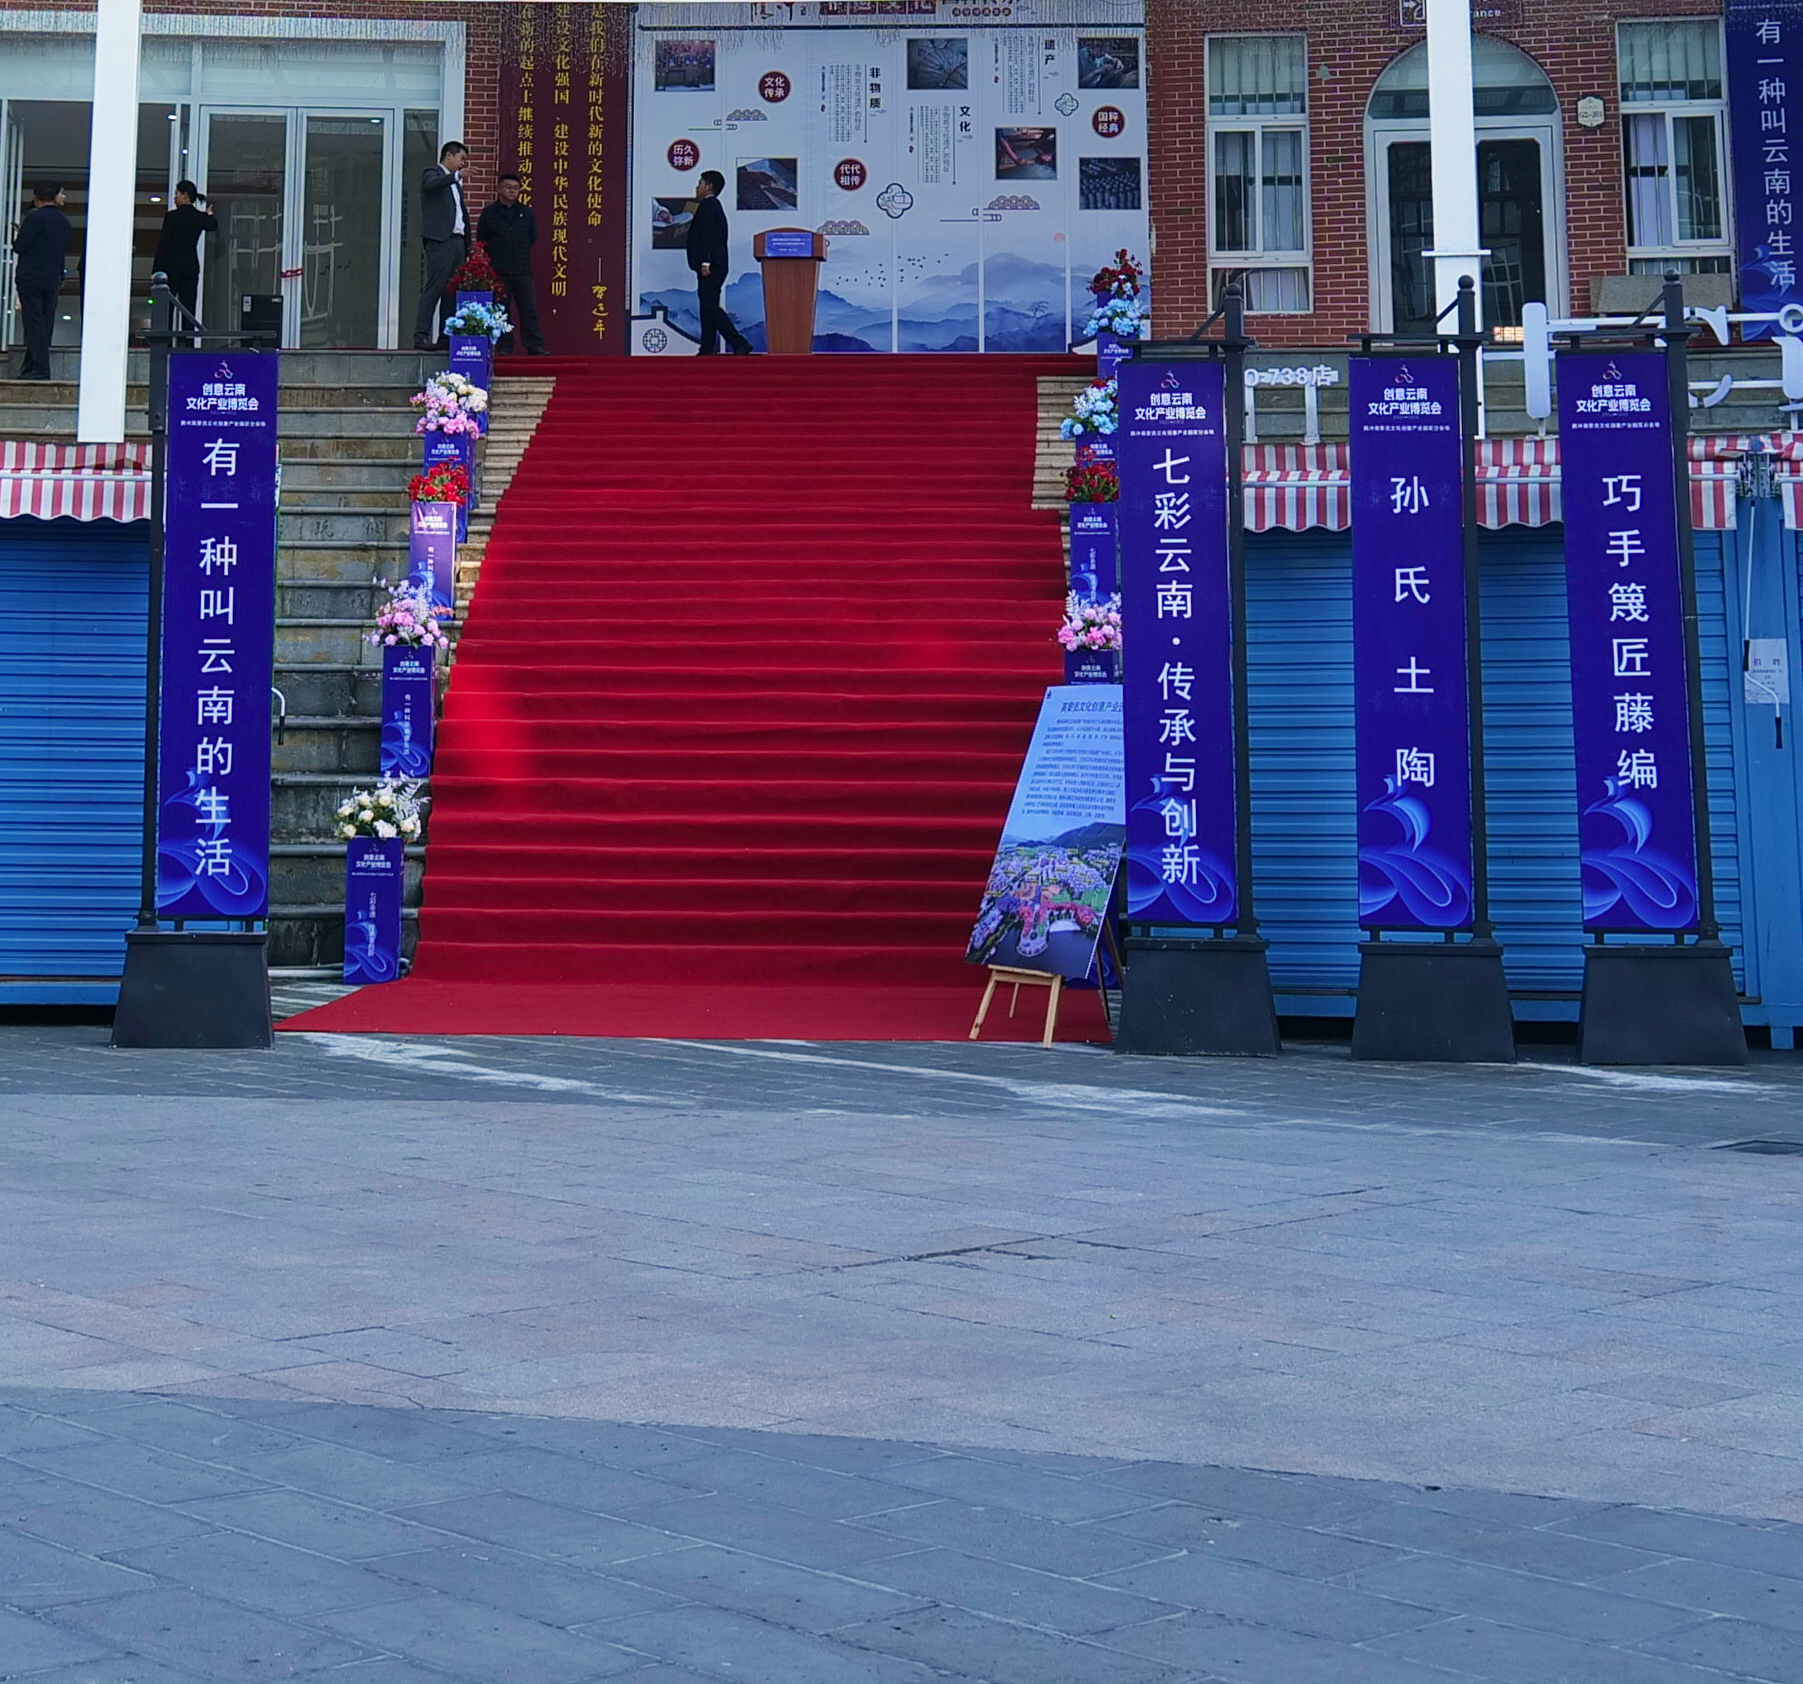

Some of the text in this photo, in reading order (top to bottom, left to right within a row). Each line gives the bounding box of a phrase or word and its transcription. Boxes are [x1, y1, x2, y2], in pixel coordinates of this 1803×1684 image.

[764, 77, 785, 87] 文化
[959, 105, 972, 133] 文化
[1755, 18, 1796, 287] 有一种叫云南的生活
[202, 383, 246, 396] 创意云南
[1383, 388, 1428, 401] 创意云南
[1591, 385, 1636, 397] 创意云南
[186, 397, 259, 411] 文化产业博览会
[1149, 393, 1193, 405] 创意云南
[1576, 398, 1651, 412] 文化产业博览会
[1134, 406, 1207, 421] 文化产业博览会
[1368, 402, 1442, 415] 文化产业博览会
[1390, 475, 1436, 788] 孙氏土陶
[1602, 475, 1658, 789] 巧手篾匠藤编
[194, 438, 241, 877] 有一种叫云南的生活
[1152, 448, 1201, 885] 七彩云南·传承与创新
